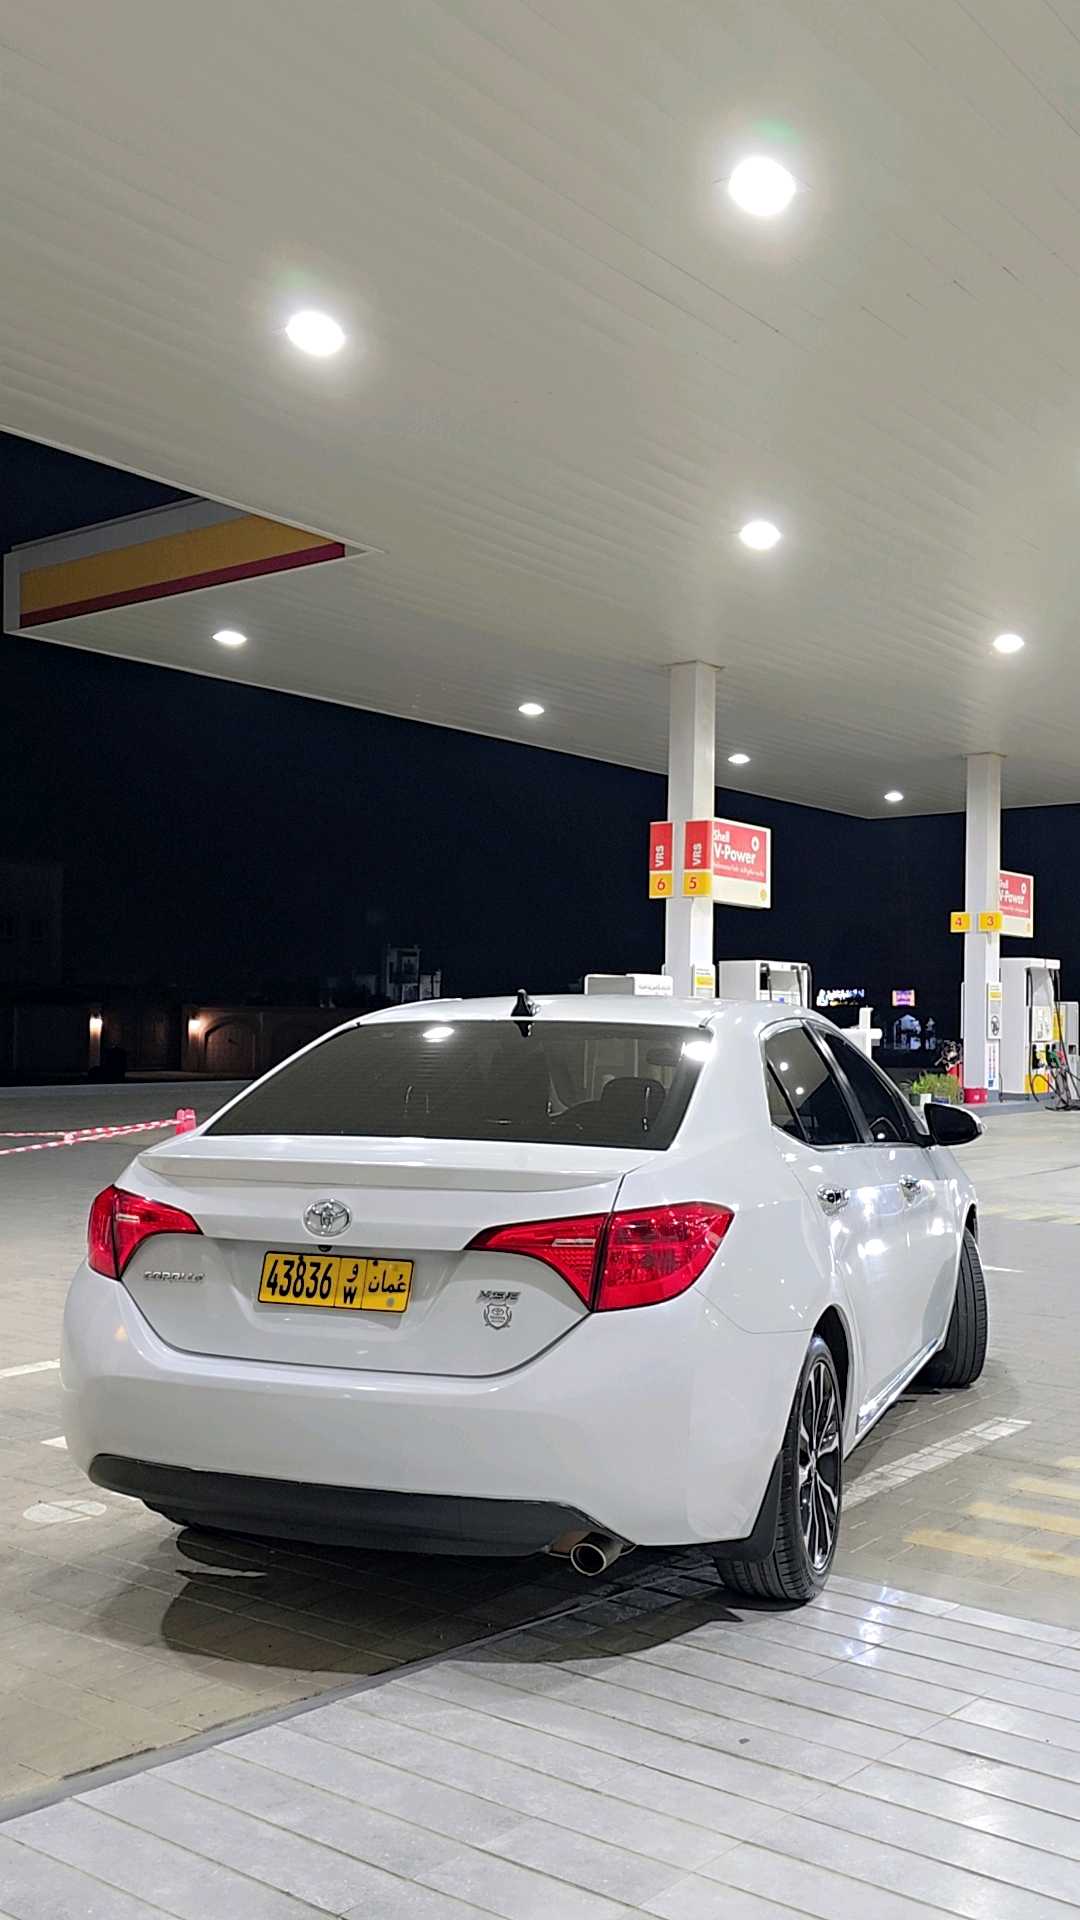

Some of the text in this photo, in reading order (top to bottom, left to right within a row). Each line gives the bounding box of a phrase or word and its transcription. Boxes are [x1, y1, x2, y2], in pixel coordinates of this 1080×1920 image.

[712, 842, 756, 865] V-Power
[657, 878, 666, 891] 6
[688, 877, 697, 889] 5
[955, 917, 962, 927] 4
[986, 915, 994, 927] 3
[266, 1259, 333, 1299] 43836
[343, 1286, 357, 1304] W
